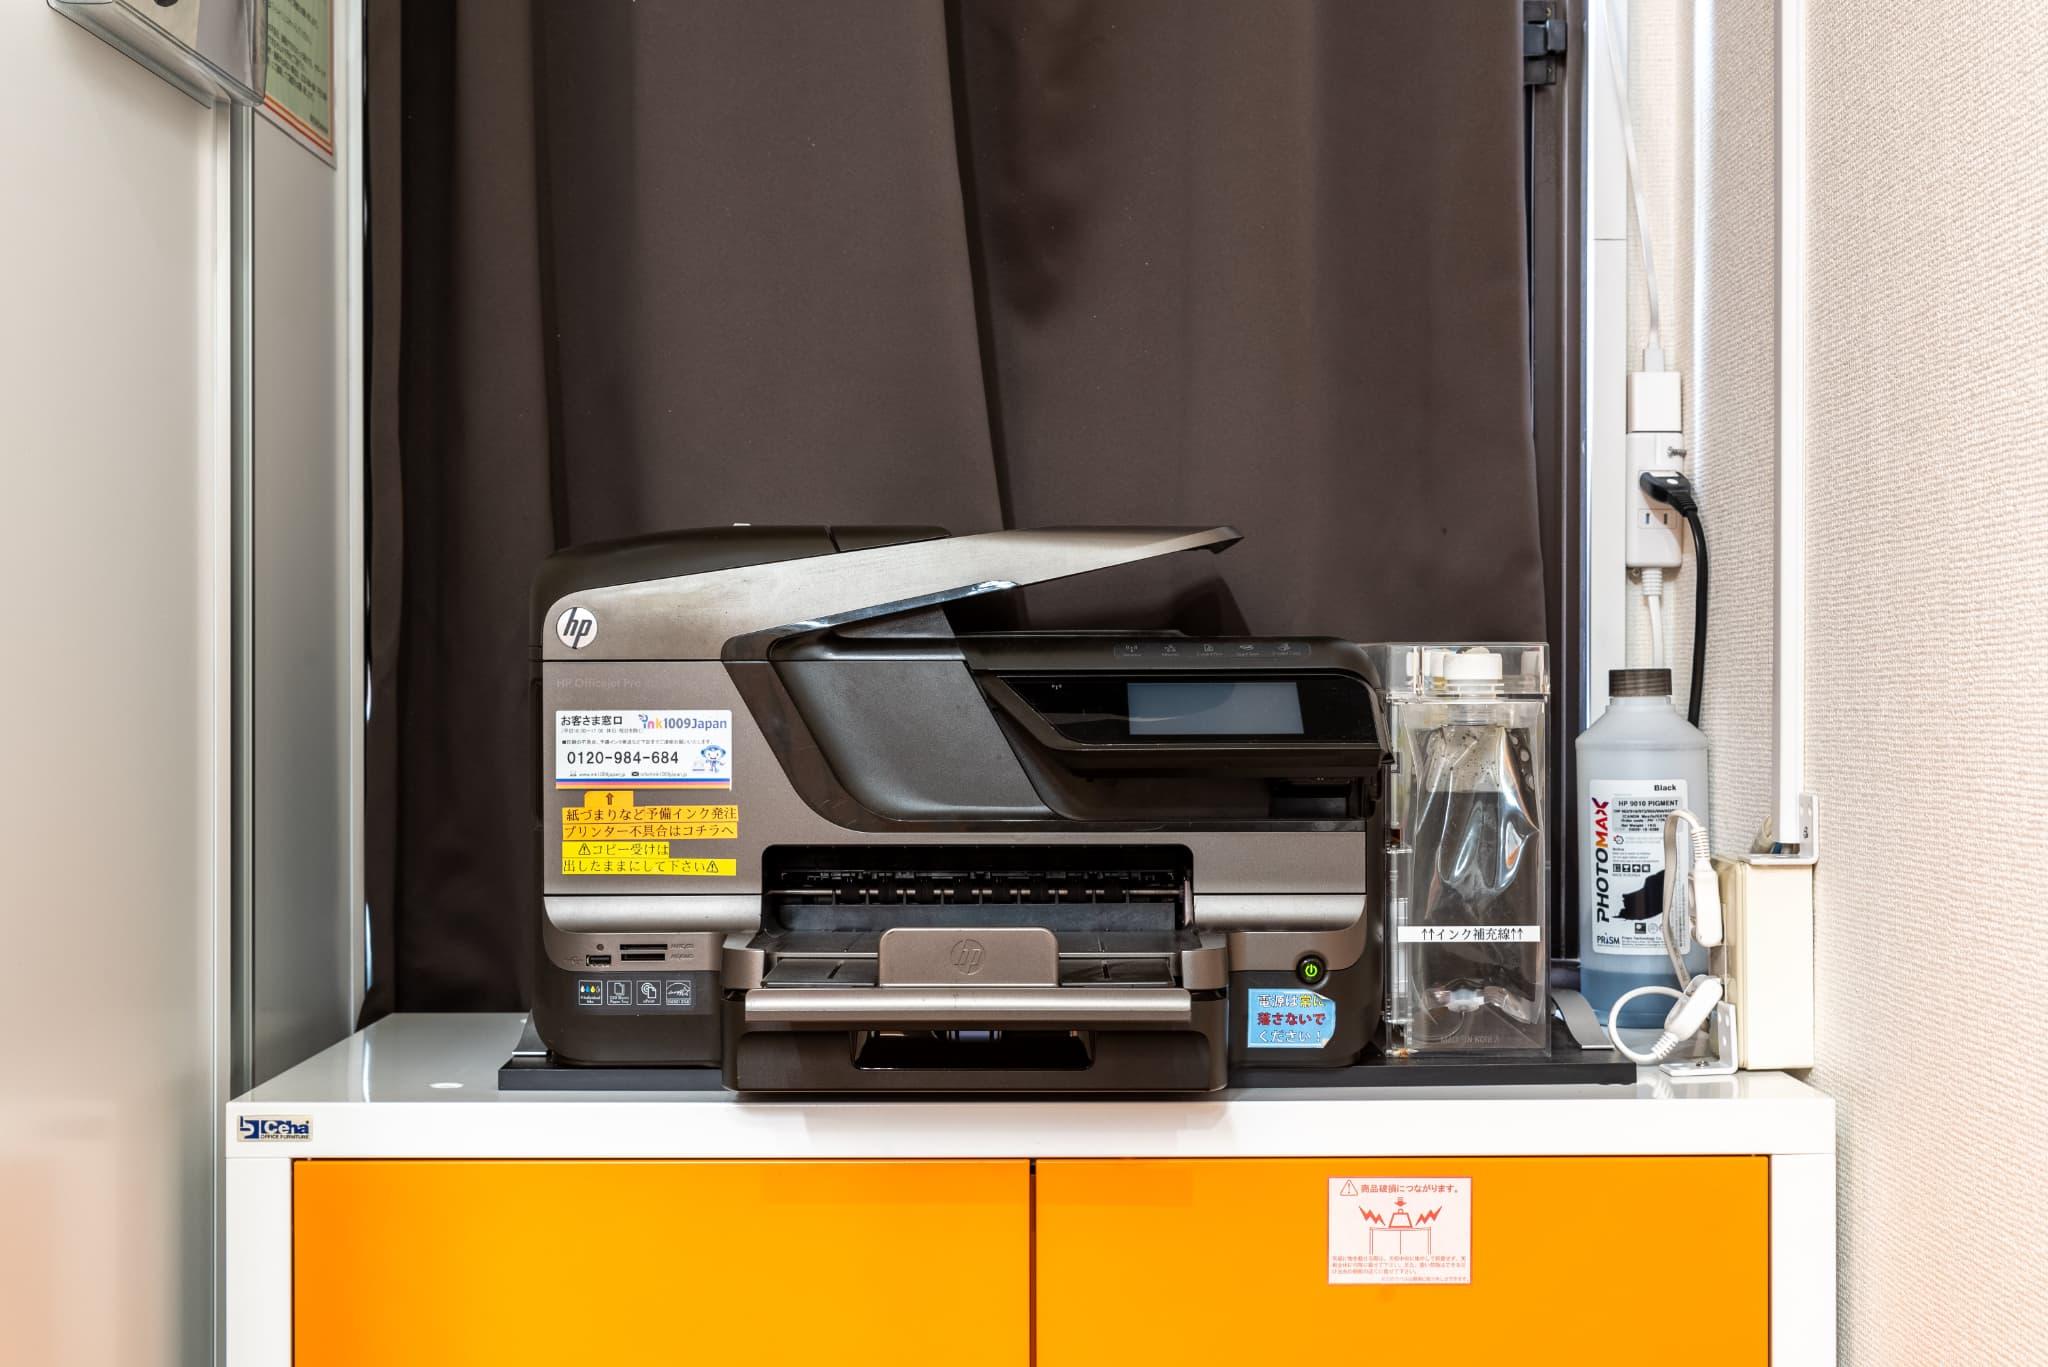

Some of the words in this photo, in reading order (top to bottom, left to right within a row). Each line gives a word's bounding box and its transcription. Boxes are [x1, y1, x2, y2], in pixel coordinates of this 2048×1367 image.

[563, 607, 593, 649] hp
[560, 715, 623, 727] お客さま窓口
[567, 751, 679, 765] 0120-984-684
[1653, 783, 1677, 792] Black
[1648, 799, 1679, 807] PIGMENT
[565, 808, 738, 822] 紙づまりなど予備インク発注
[564, 824, 735, 838] プリンター不具合はコチラへ
[592, 844, 669, 857] コピー受けは
[563, 860, 706, 873] 出したままにして下さい
[1592, 797, 1611, 923] PHOTOMAX
[1436, 927, 1511, 941] インク補充線
